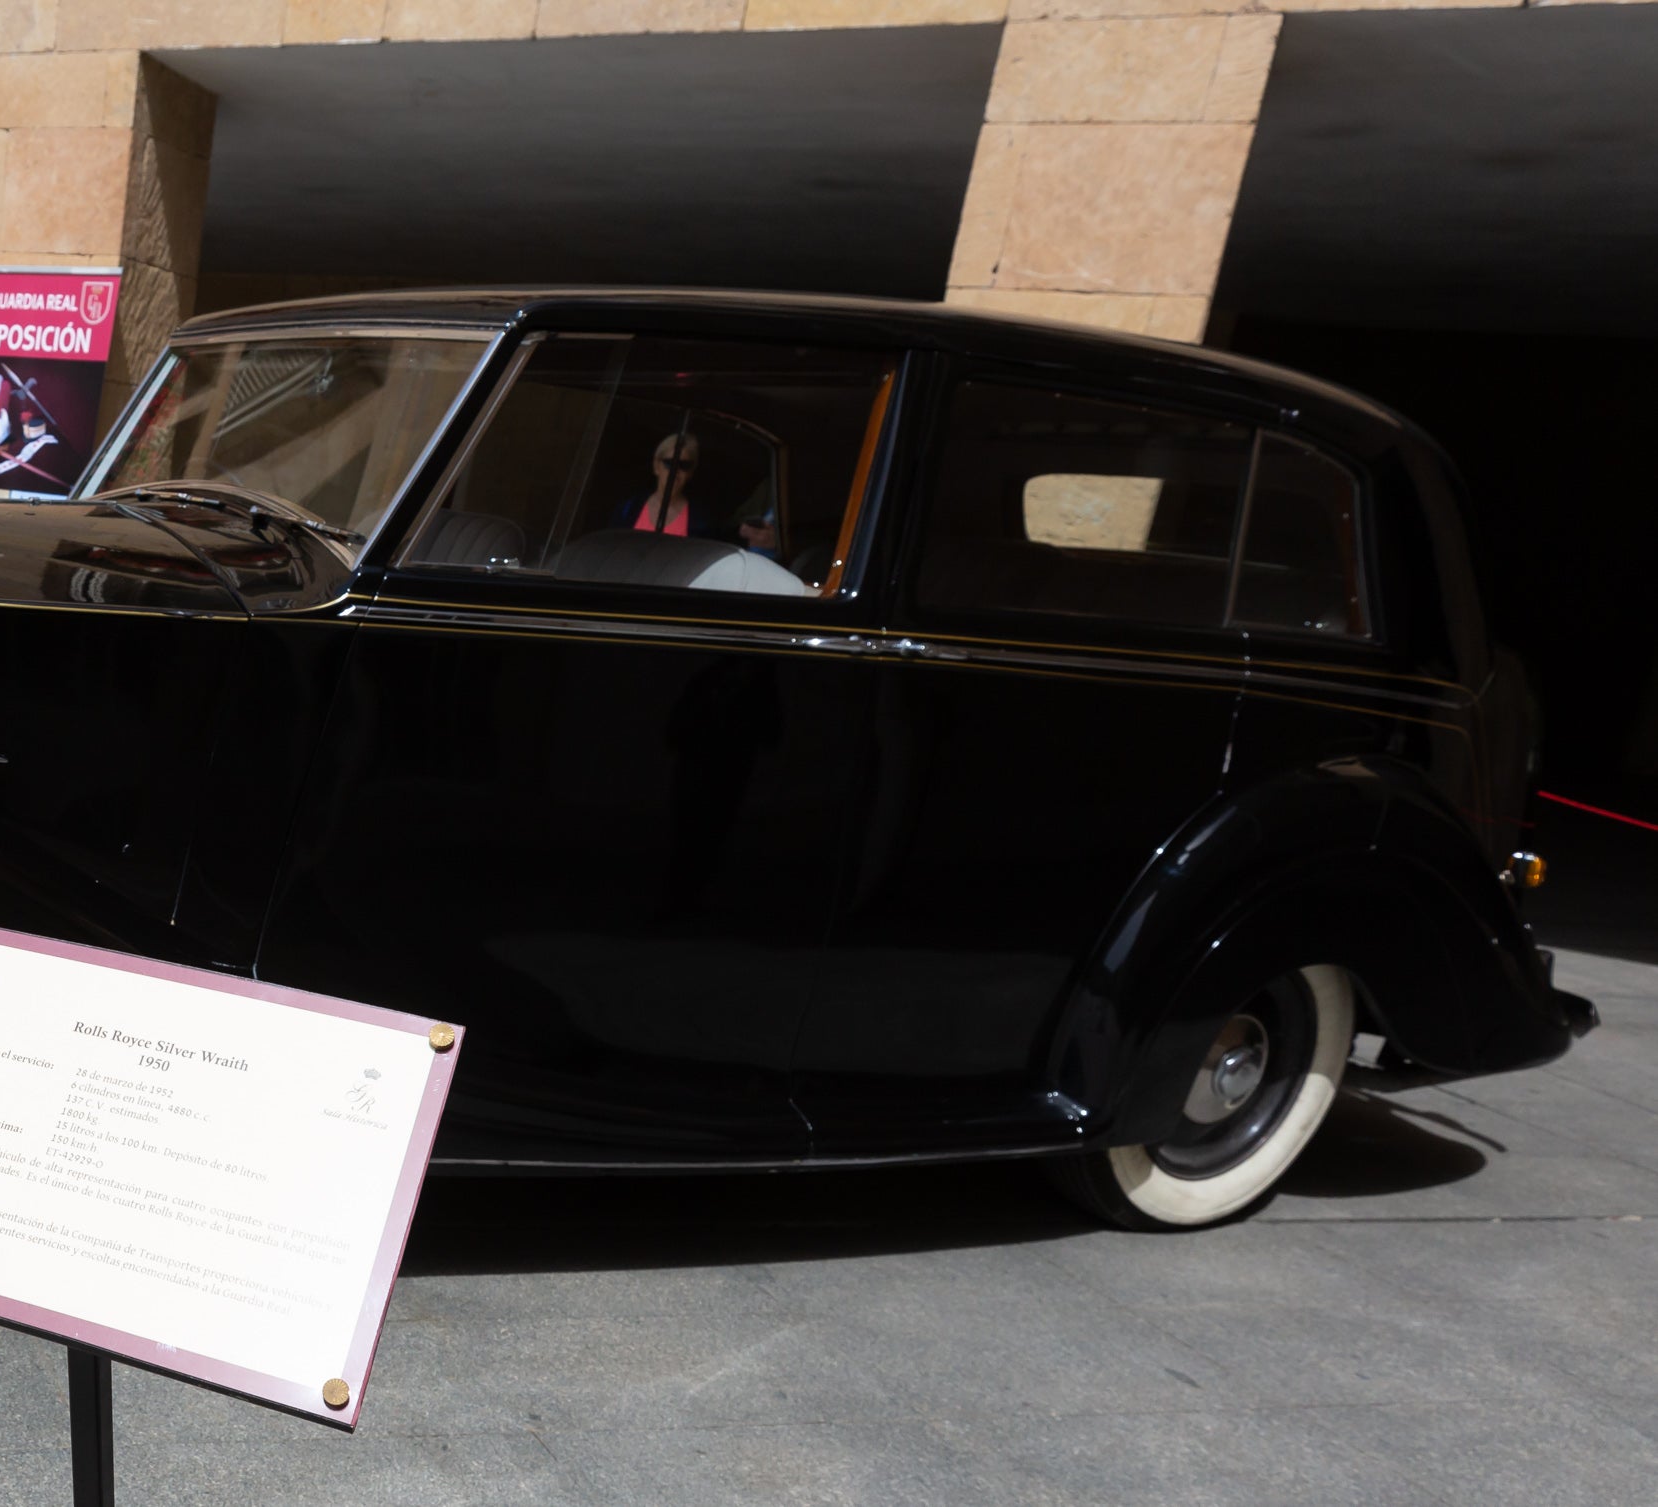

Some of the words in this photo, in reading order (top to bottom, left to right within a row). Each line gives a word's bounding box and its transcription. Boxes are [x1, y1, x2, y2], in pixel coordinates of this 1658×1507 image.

[46, 293, 78, 312] REAL
[1, 1050, 11, 1058] el
[12, 1054, 56, 1068] servicio:
[73, 1021, 108, 1037] Rolls
[111, 1030, 152, 1047] Royce
[155, 1039, 196, 1057] Silver
[199, 1049, 250, 1070] Wraith
[138, 1055, 171, 1071] 1950
[65, 1092, 84, 1105] 137
[70, 1079, 78, 1089] 6
[78, 1083, 121, 1099] cilindros
[122, 1094, 135, 1103] en
[137, 1096, 165, 1112] línea,
[167, 1103, 193, 1116] 4880
[75, 1066, 88, 1077] 28
[89, 1069, 102, 1080] de
[102, 1076, 134, 1087] marzo
[135, 1080, 148, 1092] de
[149, 1084, 175, 1097] 1952
[60, 1106, 85, 1119] 1800
[50, 1133, 69, 1146] 150
[55, 1119, 69, 1131] 15
[69, 1123, 95, 1137] litros
[96, 1132, 103, 1140] a
[105, 1132, 119, 1144] los
[121, 1136, 140, 1149] 100
[162, 1147, 208, 1166] Depósito
[209, 1158, 222, 1171] de
[224, 1162, 239, 1175] 80
[25, 1171, 38, 1183] Es
[38, 1176, 50, 1186] el
[50, 1178, 79, 1193] único
[80, 1186, 93, 1198] de
[95, 1190, 110, 1203] los
[112, 1197, 146, 1211] cuatro
[147, 1204, 173, 1219] Rolls
[175, 1212, 207, 1228] Royce
[208, 1220, 223, 1233] de
[225, 1224, 236, 1237] la
[236, 1228, 280, 1248] Guardia
[29, 1157, 41, 1168] de
[43, 1162, 63, 1173] alta
[66, 1170, 142, 1194] representación
[144, 1190, 168, 1201] para
[171, 1197, 205, 1211] cuatro
[208, 1207, 263, 1227] ocupantes
[266, 1222, 288, 1234] con
[45, 1222, 58, 1234] de
[59, 1226, 69, 1237] la
[70, 1229, 121, 1251] Compañía
[123, 1244, 136, 1256] de
[138, 1248, 202, 1274] Transportes
[26, 1236, 70, 1252] servicios
[70, 1248, 79, 1258] y
[80, 1251, 120, 1267] escoltas
[122, 1263, 200, 1290] encomendados
[201, 1285, 209, 1293] a
[210, 1285, 221, 1296] la
